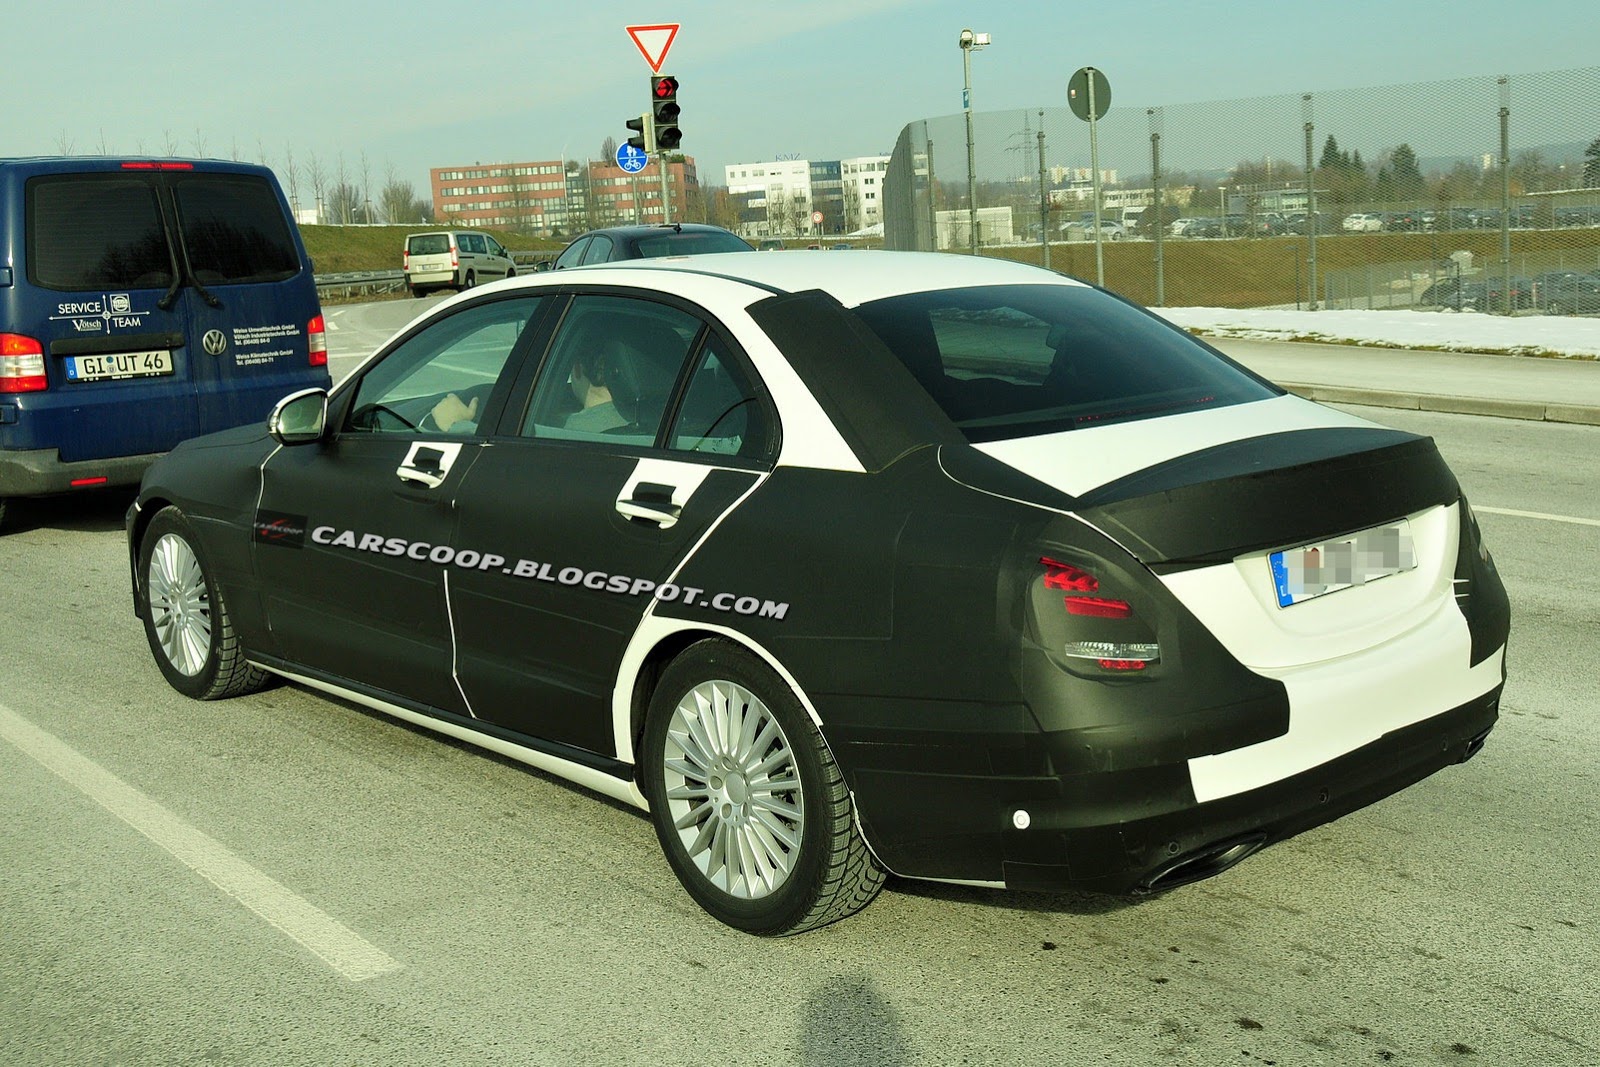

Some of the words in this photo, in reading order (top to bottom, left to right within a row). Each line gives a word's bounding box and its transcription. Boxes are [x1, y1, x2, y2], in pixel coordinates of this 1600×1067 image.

[58, 302, 102, 314] SERVICE
[72, 319, 102, 332] Vötsch
[112, 317, 141, 328] TEAM
[83, 358, 106, 375] GI
[115, 355, 138, 372] UT
[143, 353, 164, 370] 46
